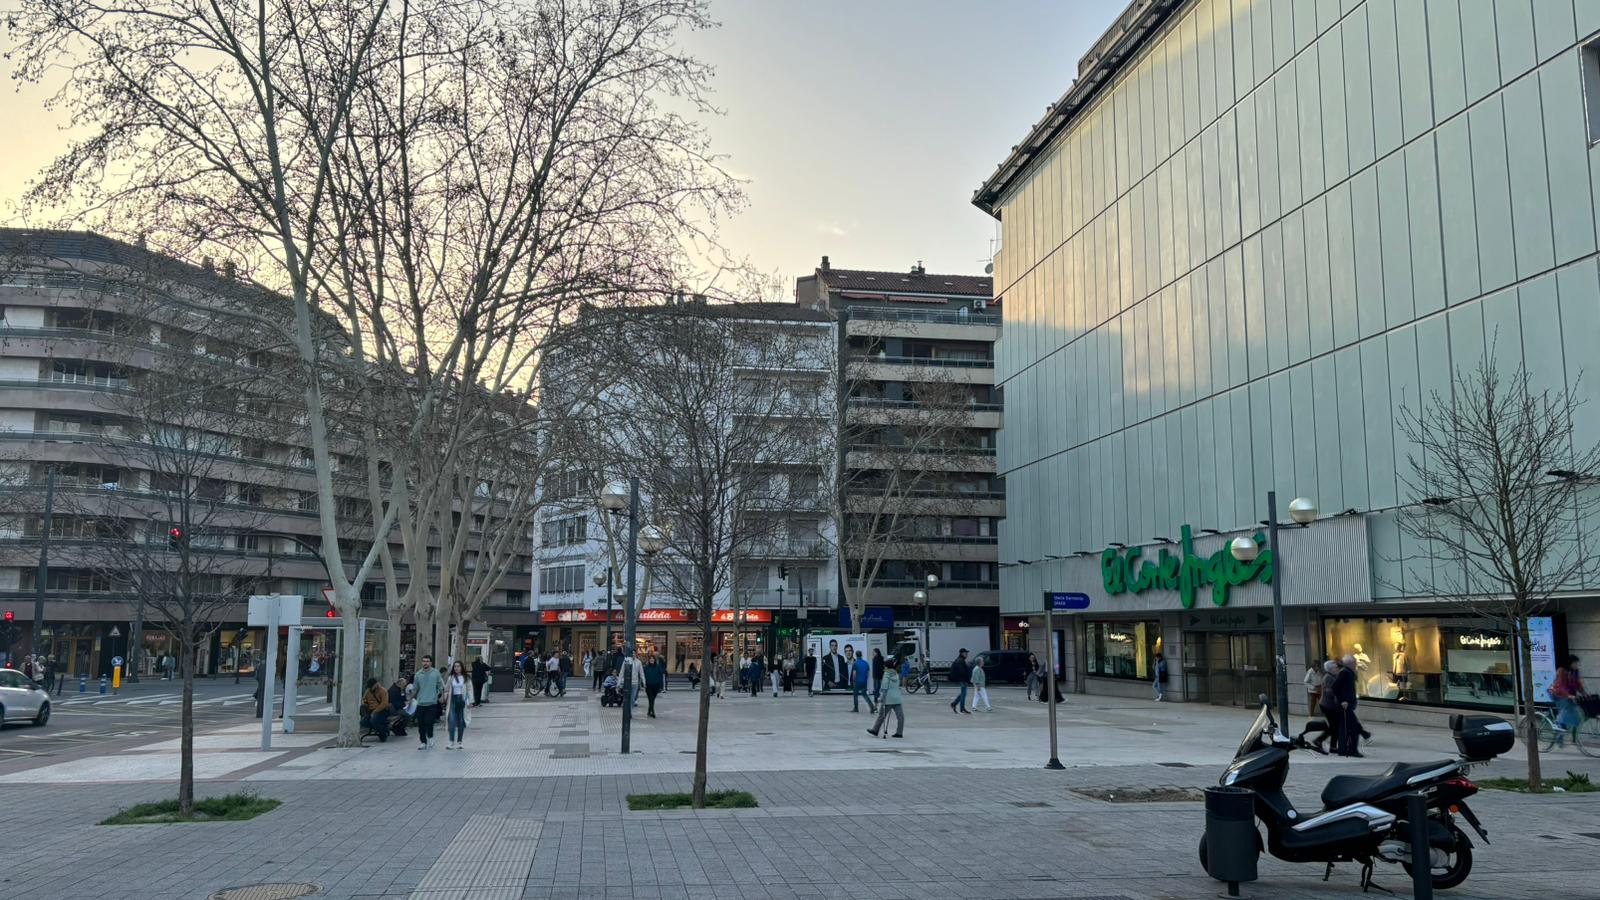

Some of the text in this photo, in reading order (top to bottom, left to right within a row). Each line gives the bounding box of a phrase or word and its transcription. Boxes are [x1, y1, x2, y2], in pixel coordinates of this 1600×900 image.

[1102, 548, 1126, 594] El
[1125, 546, 1180, 592] Corte
[1460, 635, 1467, 645] El
[1466, 635, 1480, 645] Corte
